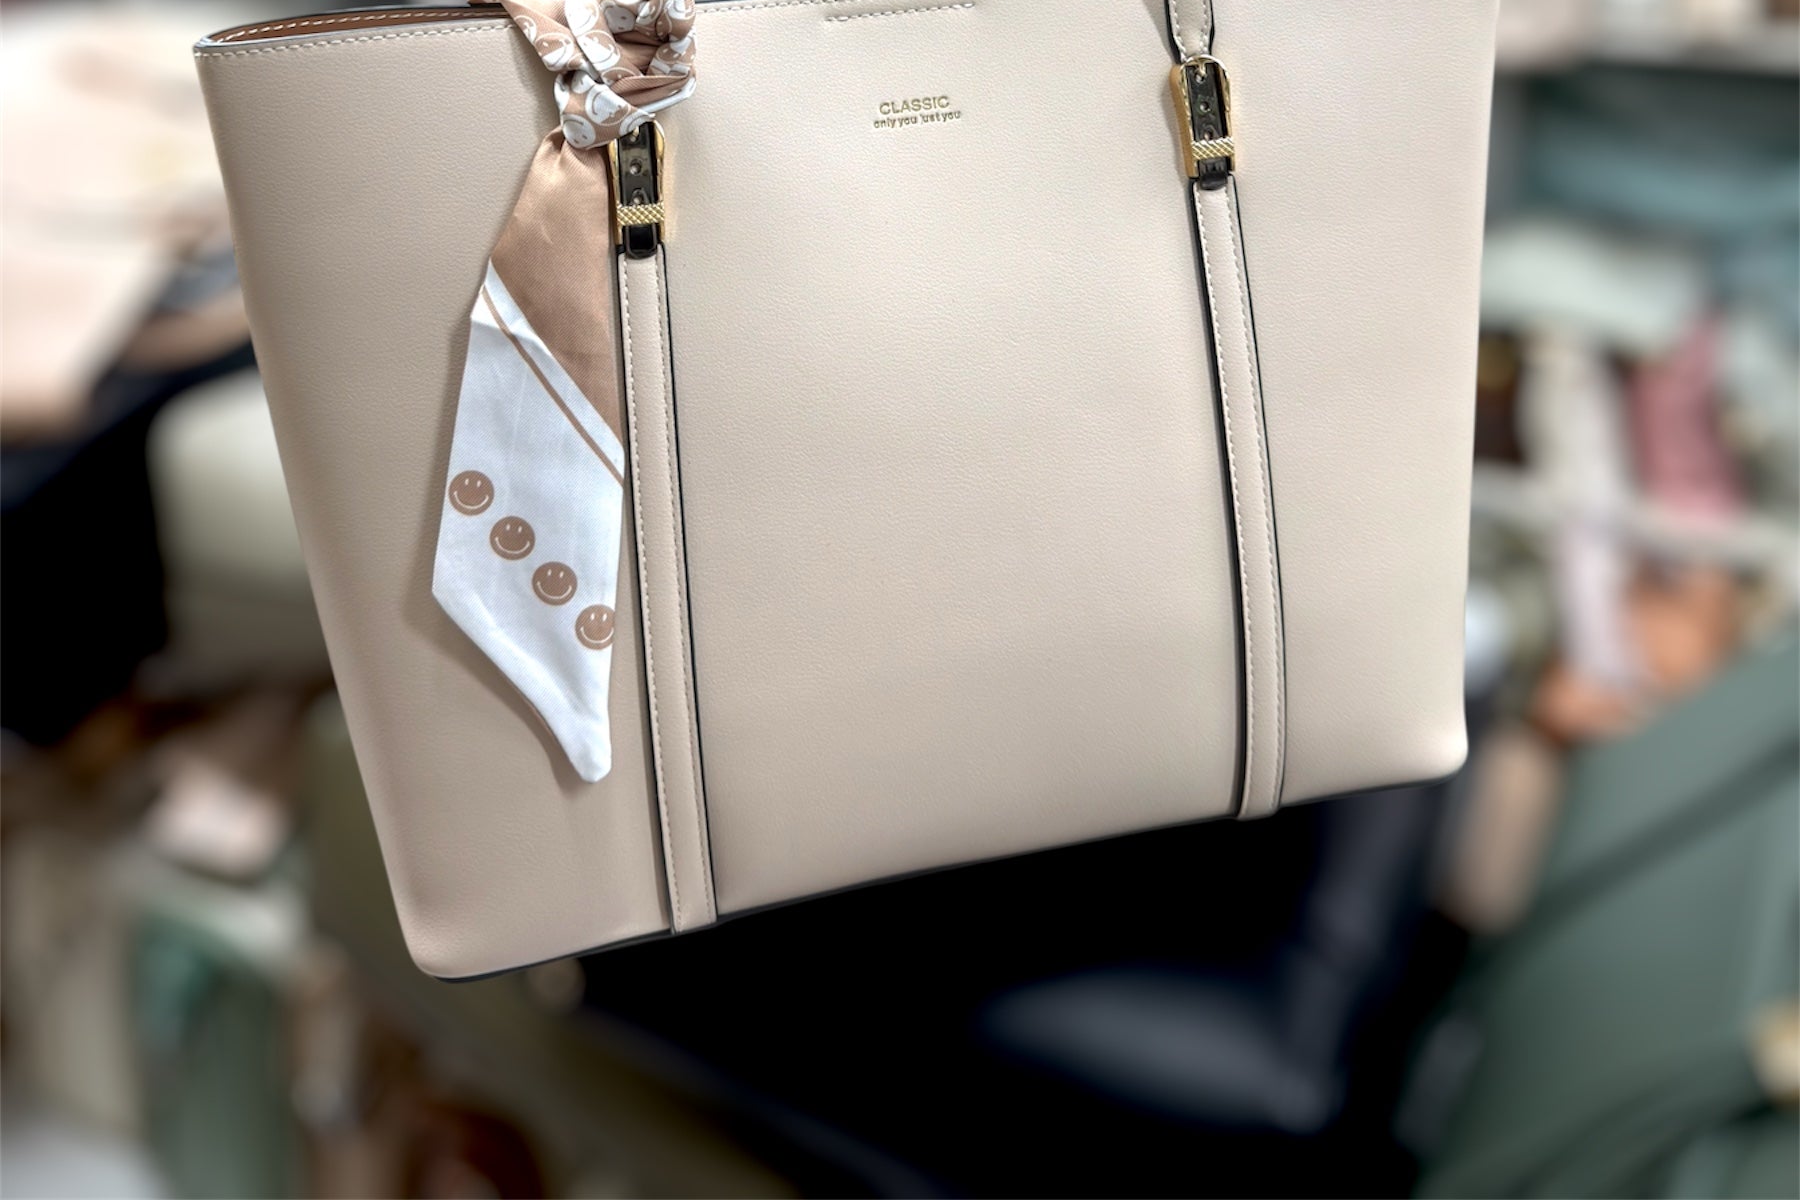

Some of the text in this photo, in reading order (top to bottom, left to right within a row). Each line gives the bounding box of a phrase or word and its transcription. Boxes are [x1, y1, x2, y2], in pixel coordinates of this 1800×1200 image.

[879, 95, 950, 115] CLASSIC
[873, 117, 896, 129] only
[898, 115, 917, 128] you
[941, 110, 962, 122] you
